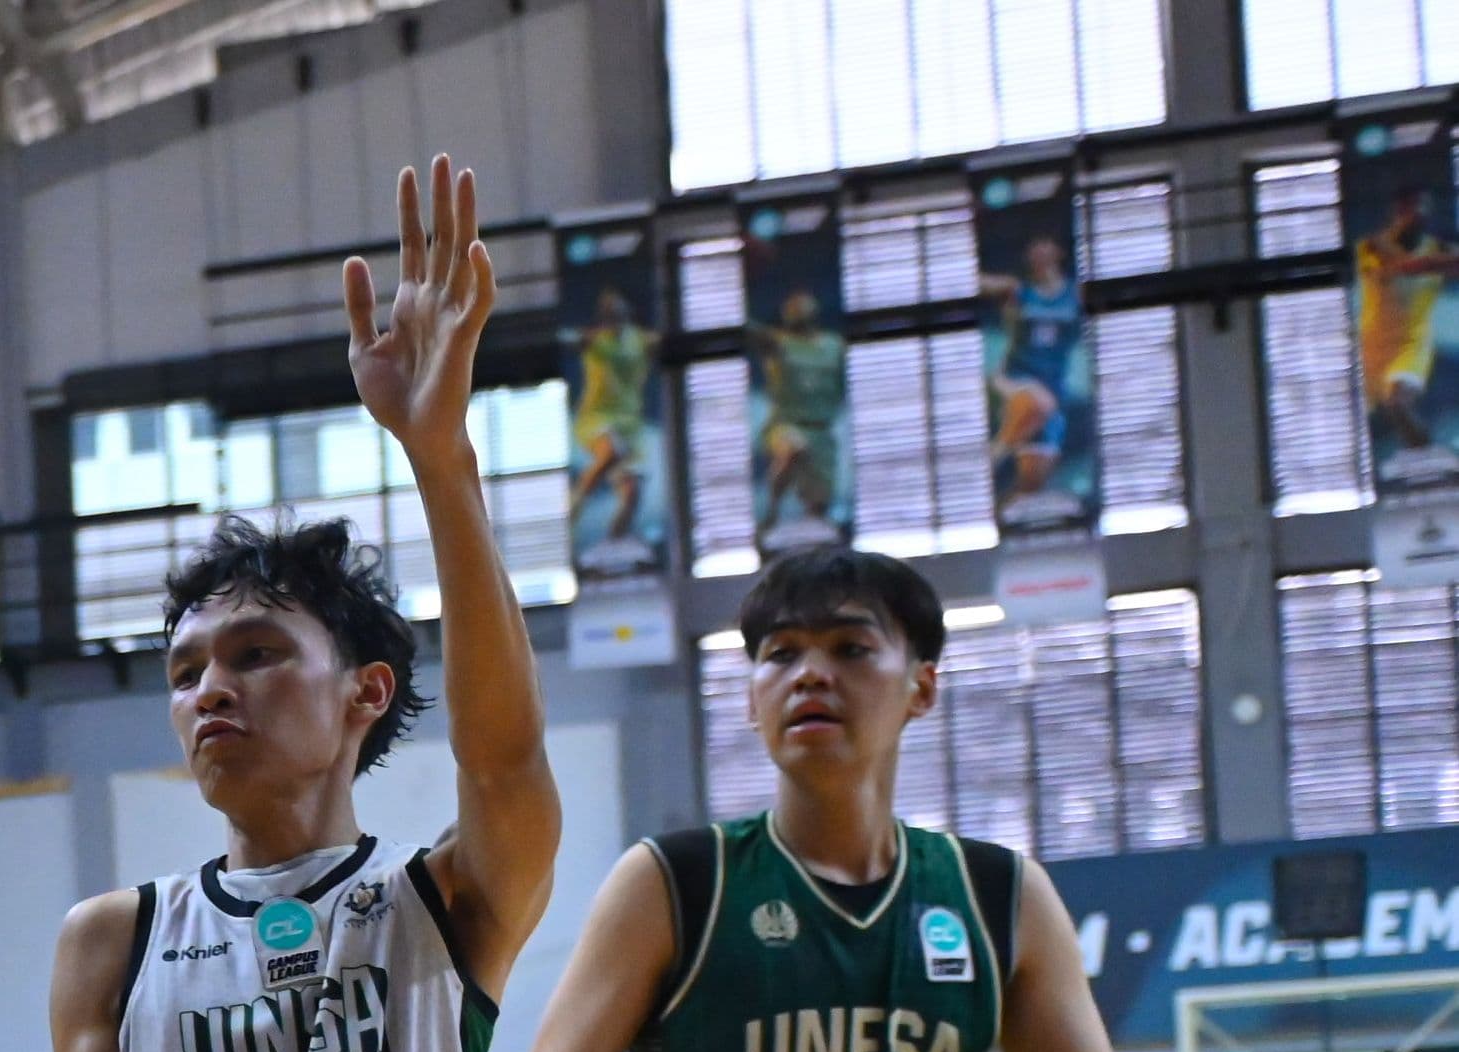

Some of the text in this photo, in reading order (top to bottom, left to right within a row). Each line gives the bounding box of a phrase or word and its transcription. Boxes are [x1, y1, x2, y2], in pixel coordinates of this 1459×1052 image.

[1167, 885, 1459, 972] ACEM
[267, 950, 319, 971] CAMPUS
[270, 961, 317, 983] LEAGUE
